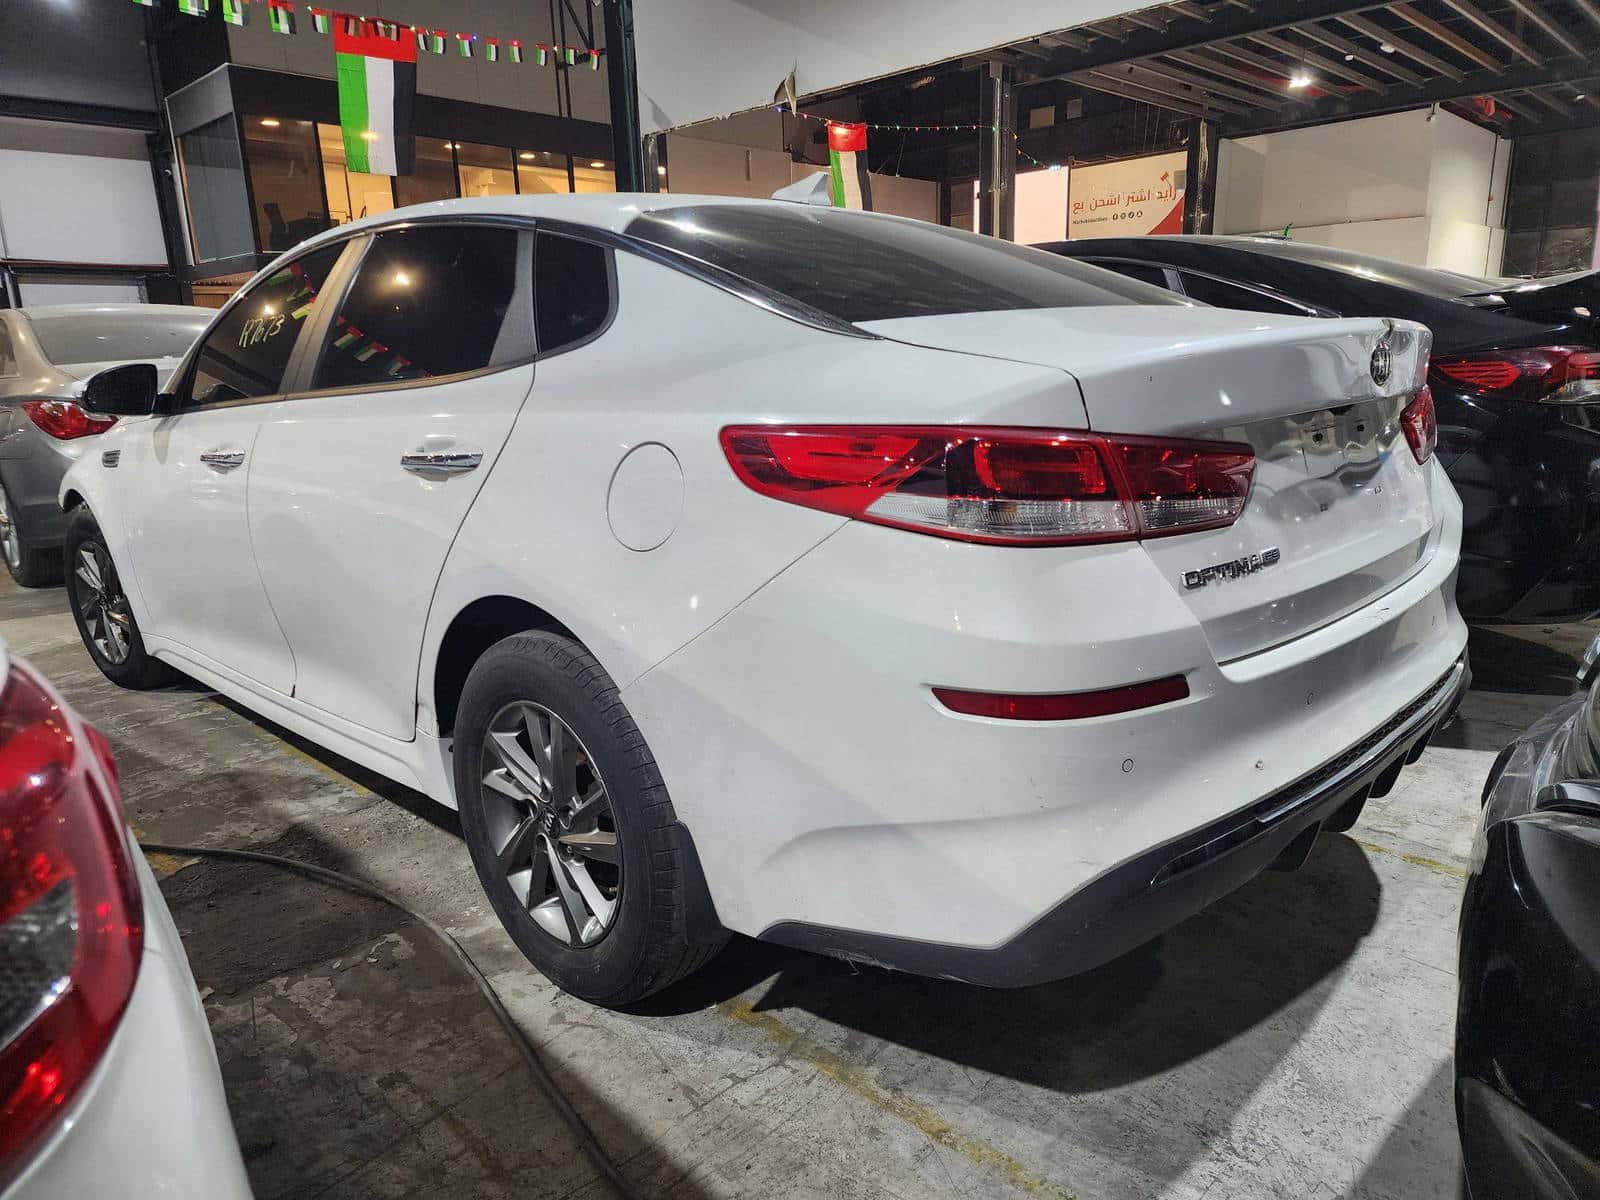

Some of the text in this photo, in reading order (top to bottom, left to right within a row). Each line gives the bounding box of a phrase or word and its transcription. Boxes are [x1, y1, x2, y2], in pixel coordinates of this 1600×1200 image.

[1072, 200, 1084, 214] بع
[1089, 192, 1121, 212] اشحن
[1125, 188, 1151, 207] اشتر
[1182, 554, 1263, 590] OPTIMA
